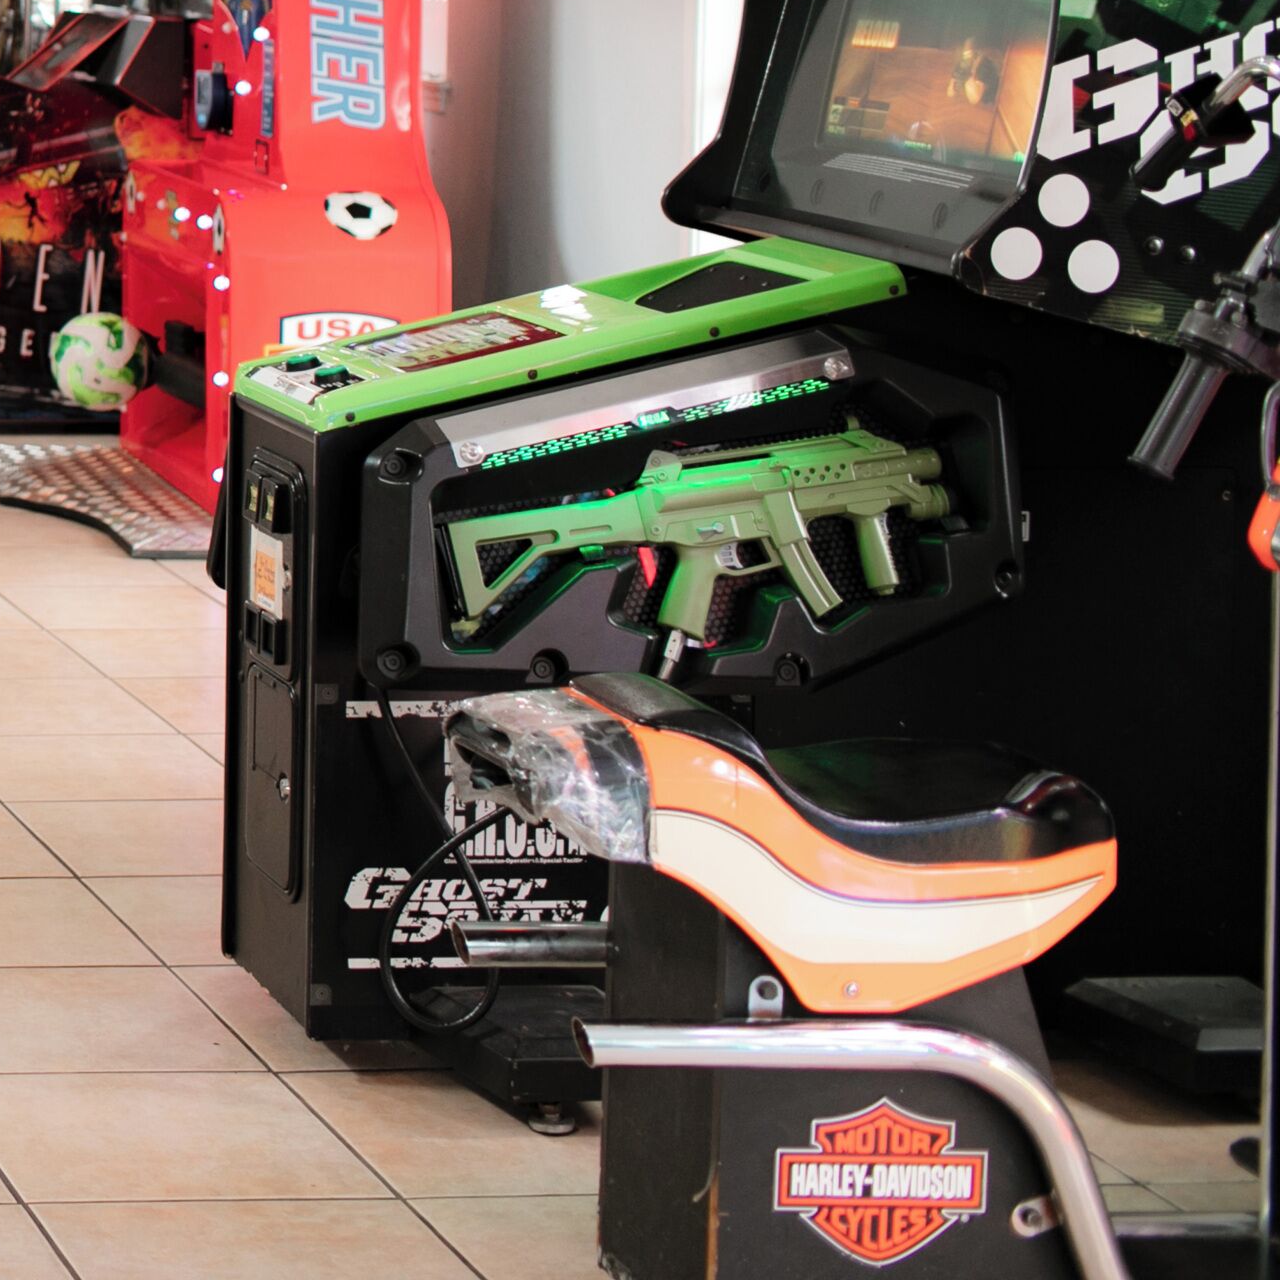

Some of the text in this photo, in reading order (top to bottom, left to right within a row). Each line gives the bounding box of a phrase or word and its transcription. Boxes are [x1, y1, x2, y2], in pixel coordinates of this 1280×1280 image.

[297, 318, 378, 340] USA
[344, 867, 548, 910] GHOST
[833, 1120, 932, 1154] MOTOR
[790, 1162, 973, 1200] HARLEY-DAVIDSON
[831, 1208, 927, 1251] CYCLES
